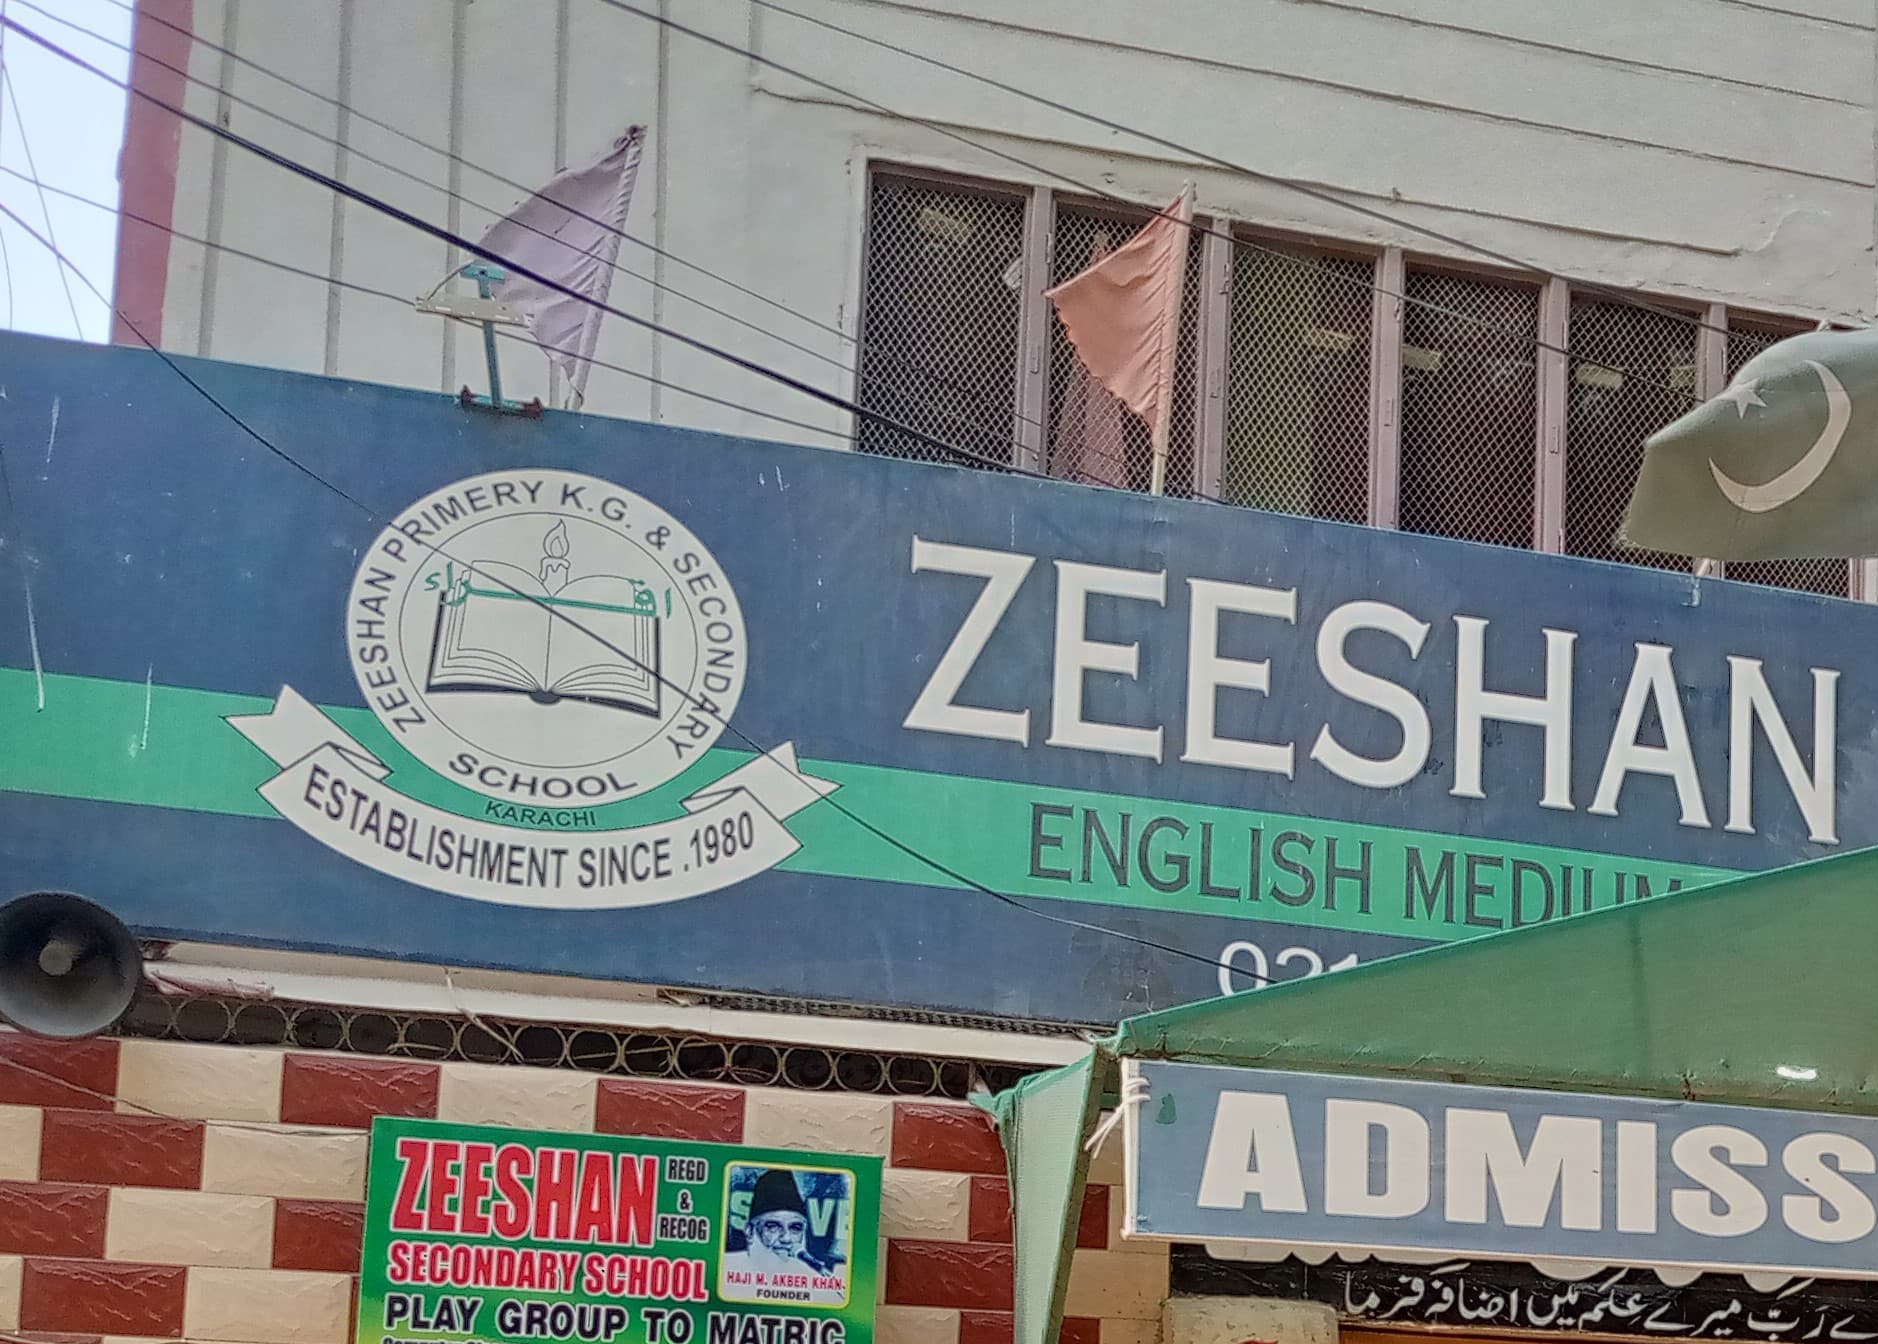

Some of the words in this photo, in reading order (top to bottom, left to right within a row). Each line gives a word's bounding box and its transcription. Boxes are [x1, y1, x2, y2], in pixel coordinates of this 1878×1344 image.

[382, 480, 543, 562] PRIMERY
[560, 484, 632, 530] K.G.
[644, 526, 670, 551] &
[357, 568, 425, 732] ZEESHAN
[665, 551, 736, 760] SECONDARY
[903, 534, 1841, 845] ZEESHAN
[449, 752, 639, 798] SCHOOL
[303, 764, 568, 889] ESTABLISHMENT
[578, 837, 671, 889] SINCE
[485, 801, 597, 829] KARACHI
[1029, 800, 1373, 915] ENGLISH
[391, 1139, 657, 1247] ZEESHAN
[667, 1157, 707, 1182] REGD
[679, 1191, 691, 1211] &
[658, 1216, 708, 1241] RECOG
[388, 1243, 578, 1293] SECONDARY
[584, 1255, 709, 1301] SCHOOL
[726, 1271, 751, 1285] HAJI
[772, 1274, 808, 1287] AKBER
[756, 1289, 811, 1301] FOUNDER
[384, 1294, 482, 1334] PLAY
[498, 1301, 628, 1343] GROUP
